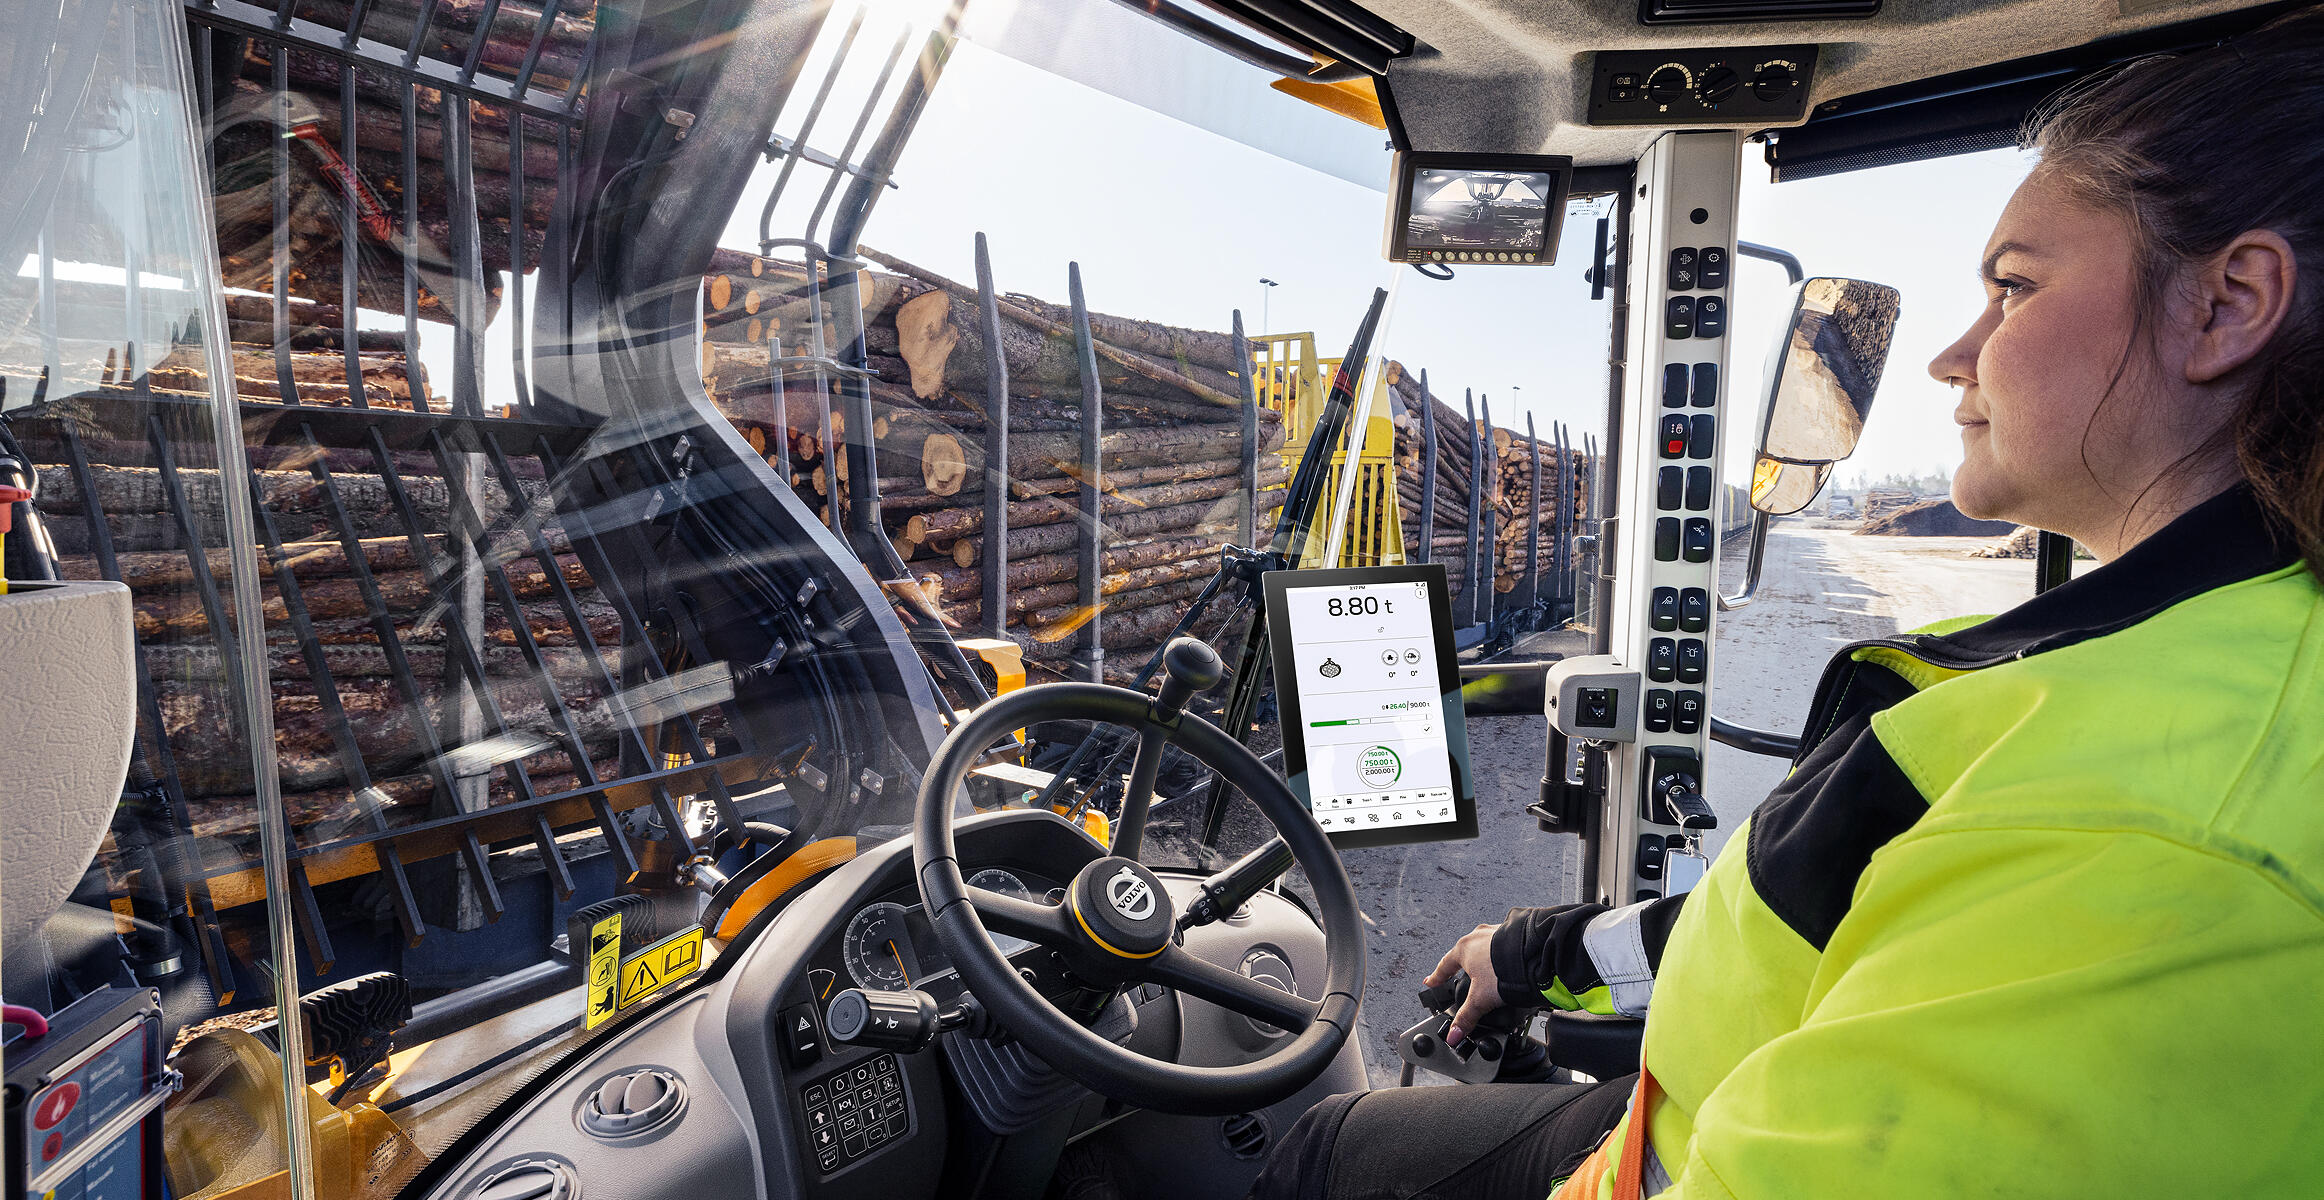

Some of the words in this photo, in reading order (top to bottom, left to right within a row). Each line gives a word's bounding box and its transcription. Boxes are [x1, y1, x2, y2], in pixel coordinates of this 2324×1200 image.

[1328, 596, 1378, 616] 8.80
[1384, 600, 1393, 614] t
[1365, 758, 1388, 767] 750.00
[1116, 881, 1146, 910] VOLVO
[809, 1091, 821, 1101] ESC
[885, 1097, 900, 1108] SETUP
